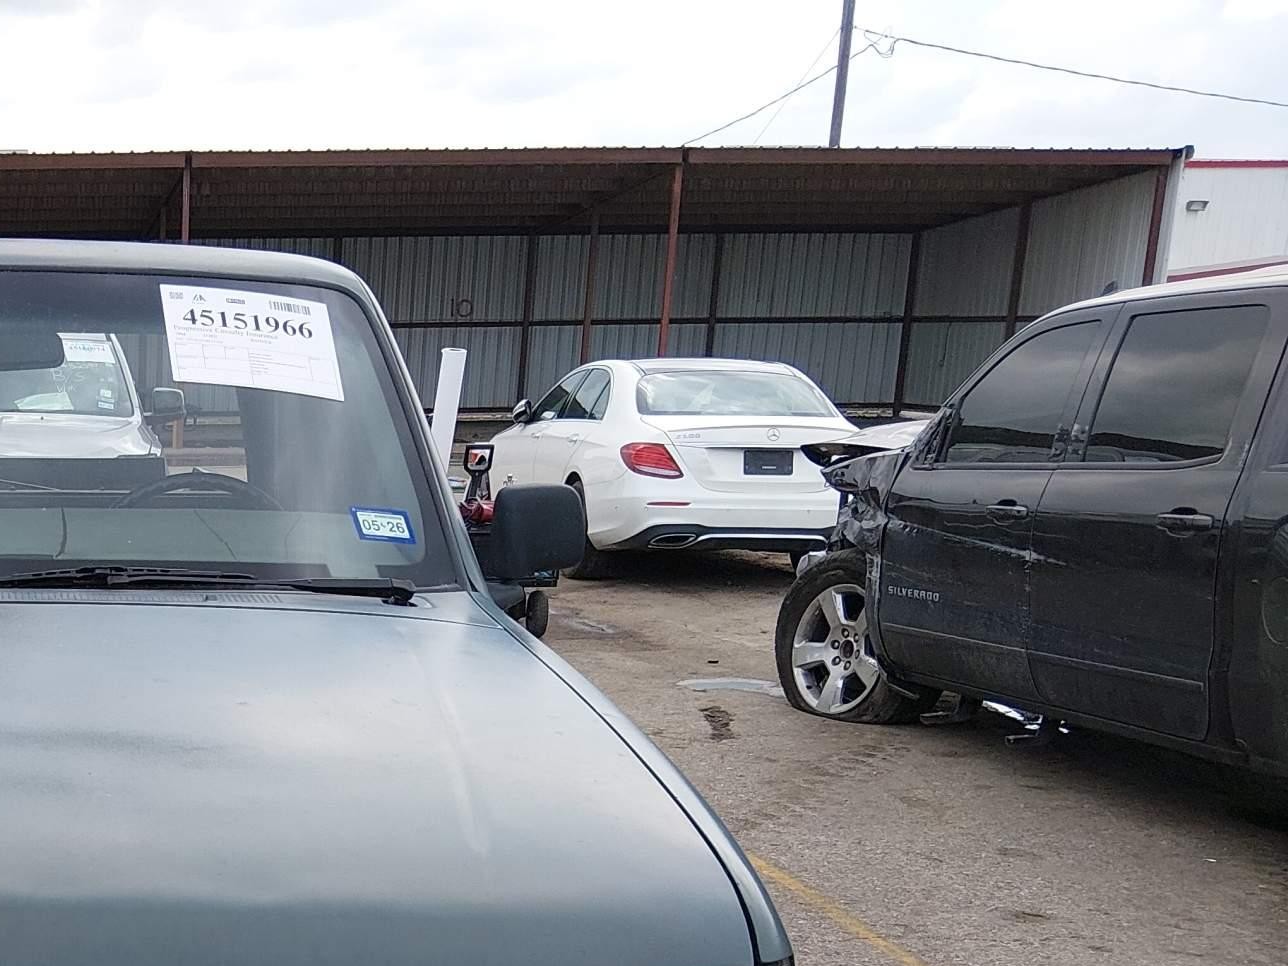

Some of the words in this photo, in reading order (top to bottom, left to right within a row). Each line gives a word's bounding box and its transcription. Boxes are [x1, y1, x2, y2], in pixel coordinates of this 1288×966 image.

[182, 308, 313, 339] 45151966
[362, 519, 381, 531] 05
[387, 521, 406, 534] 26
[887, 585, 940, 602] SILVERADO
